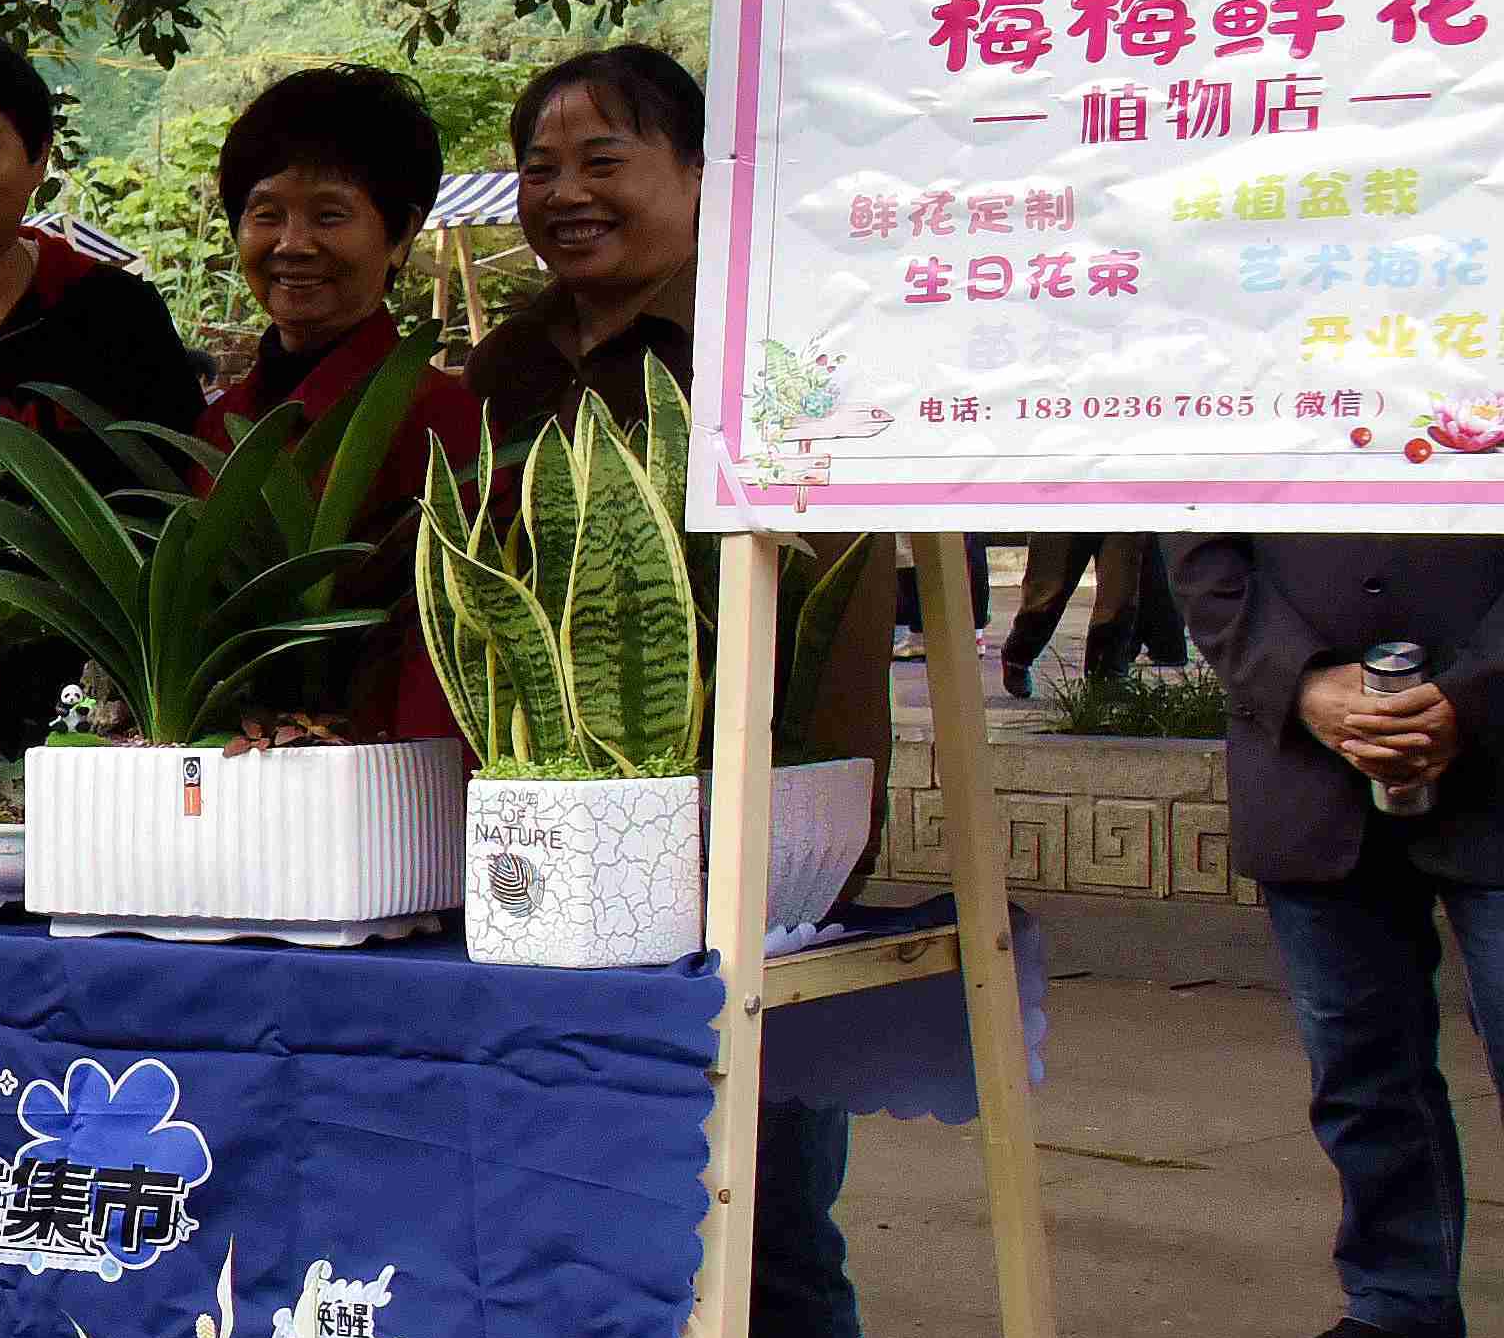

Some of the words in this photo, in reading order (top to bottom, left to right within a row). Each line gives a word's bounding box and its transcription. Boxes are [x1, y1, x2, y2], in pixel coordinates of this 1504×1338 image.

[1079, 72, 1325, 145] 植物店
[847, 185, 1076, 240] 鲜花定制
[904, 249, 1143, 305] 生日花束
[1300, 311, 1504, 361] 开业花
[1016, 396, 1073, 421] 183
[1083, 394, 1165, 419] 0236
[1174, 393, 1256, 418] 7685
[475, 823, 564, 850] NATURE
